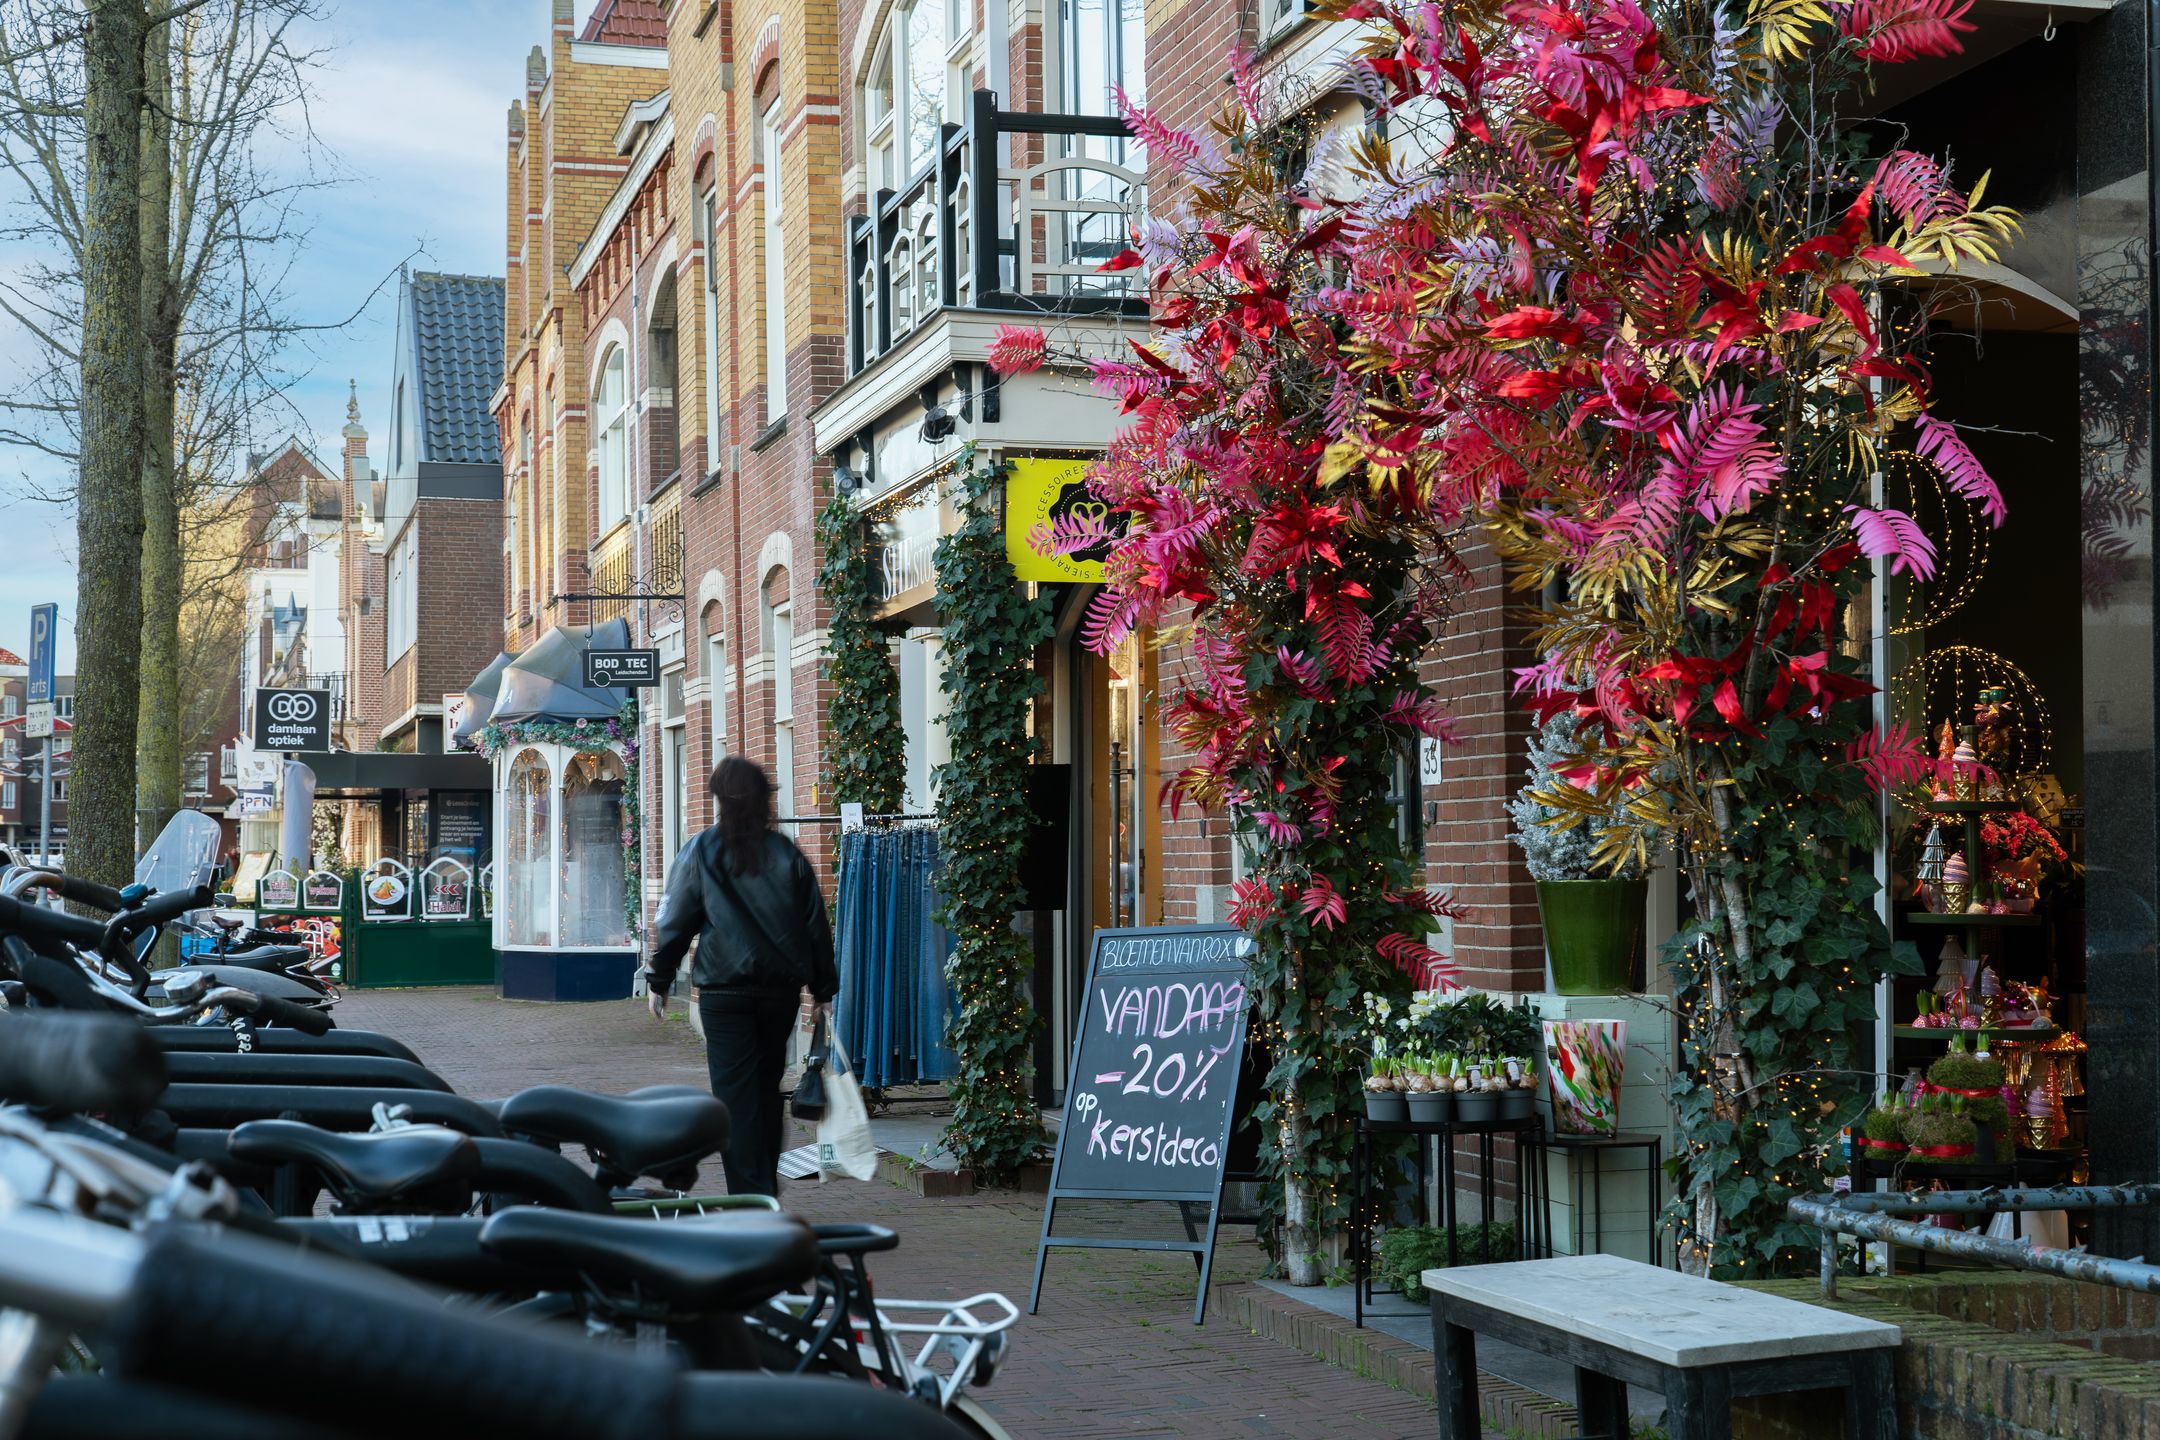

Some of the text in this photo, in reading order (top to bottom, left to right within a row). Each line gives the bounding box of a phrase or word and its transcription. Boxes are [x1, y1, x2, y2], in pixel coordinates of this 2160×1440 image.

[33, 613, 47, 660] P
[595, 658, 648, 669] BOD TEC
[31, 680, 47, 694] arts
[267, 723, 317, 734] damlaan
[267, 736, 305, 747] optiek
[1423, 747, 1438, 775] 35
[245, 796, 272, 808] PFN
[430, 901, 461, 913] Halal
[1095, 1043, 1219, 1103] -20%
[1075, 1092, 1098, 1123] op
[1087, 1109, 1219, 1167] Kerstdeco
